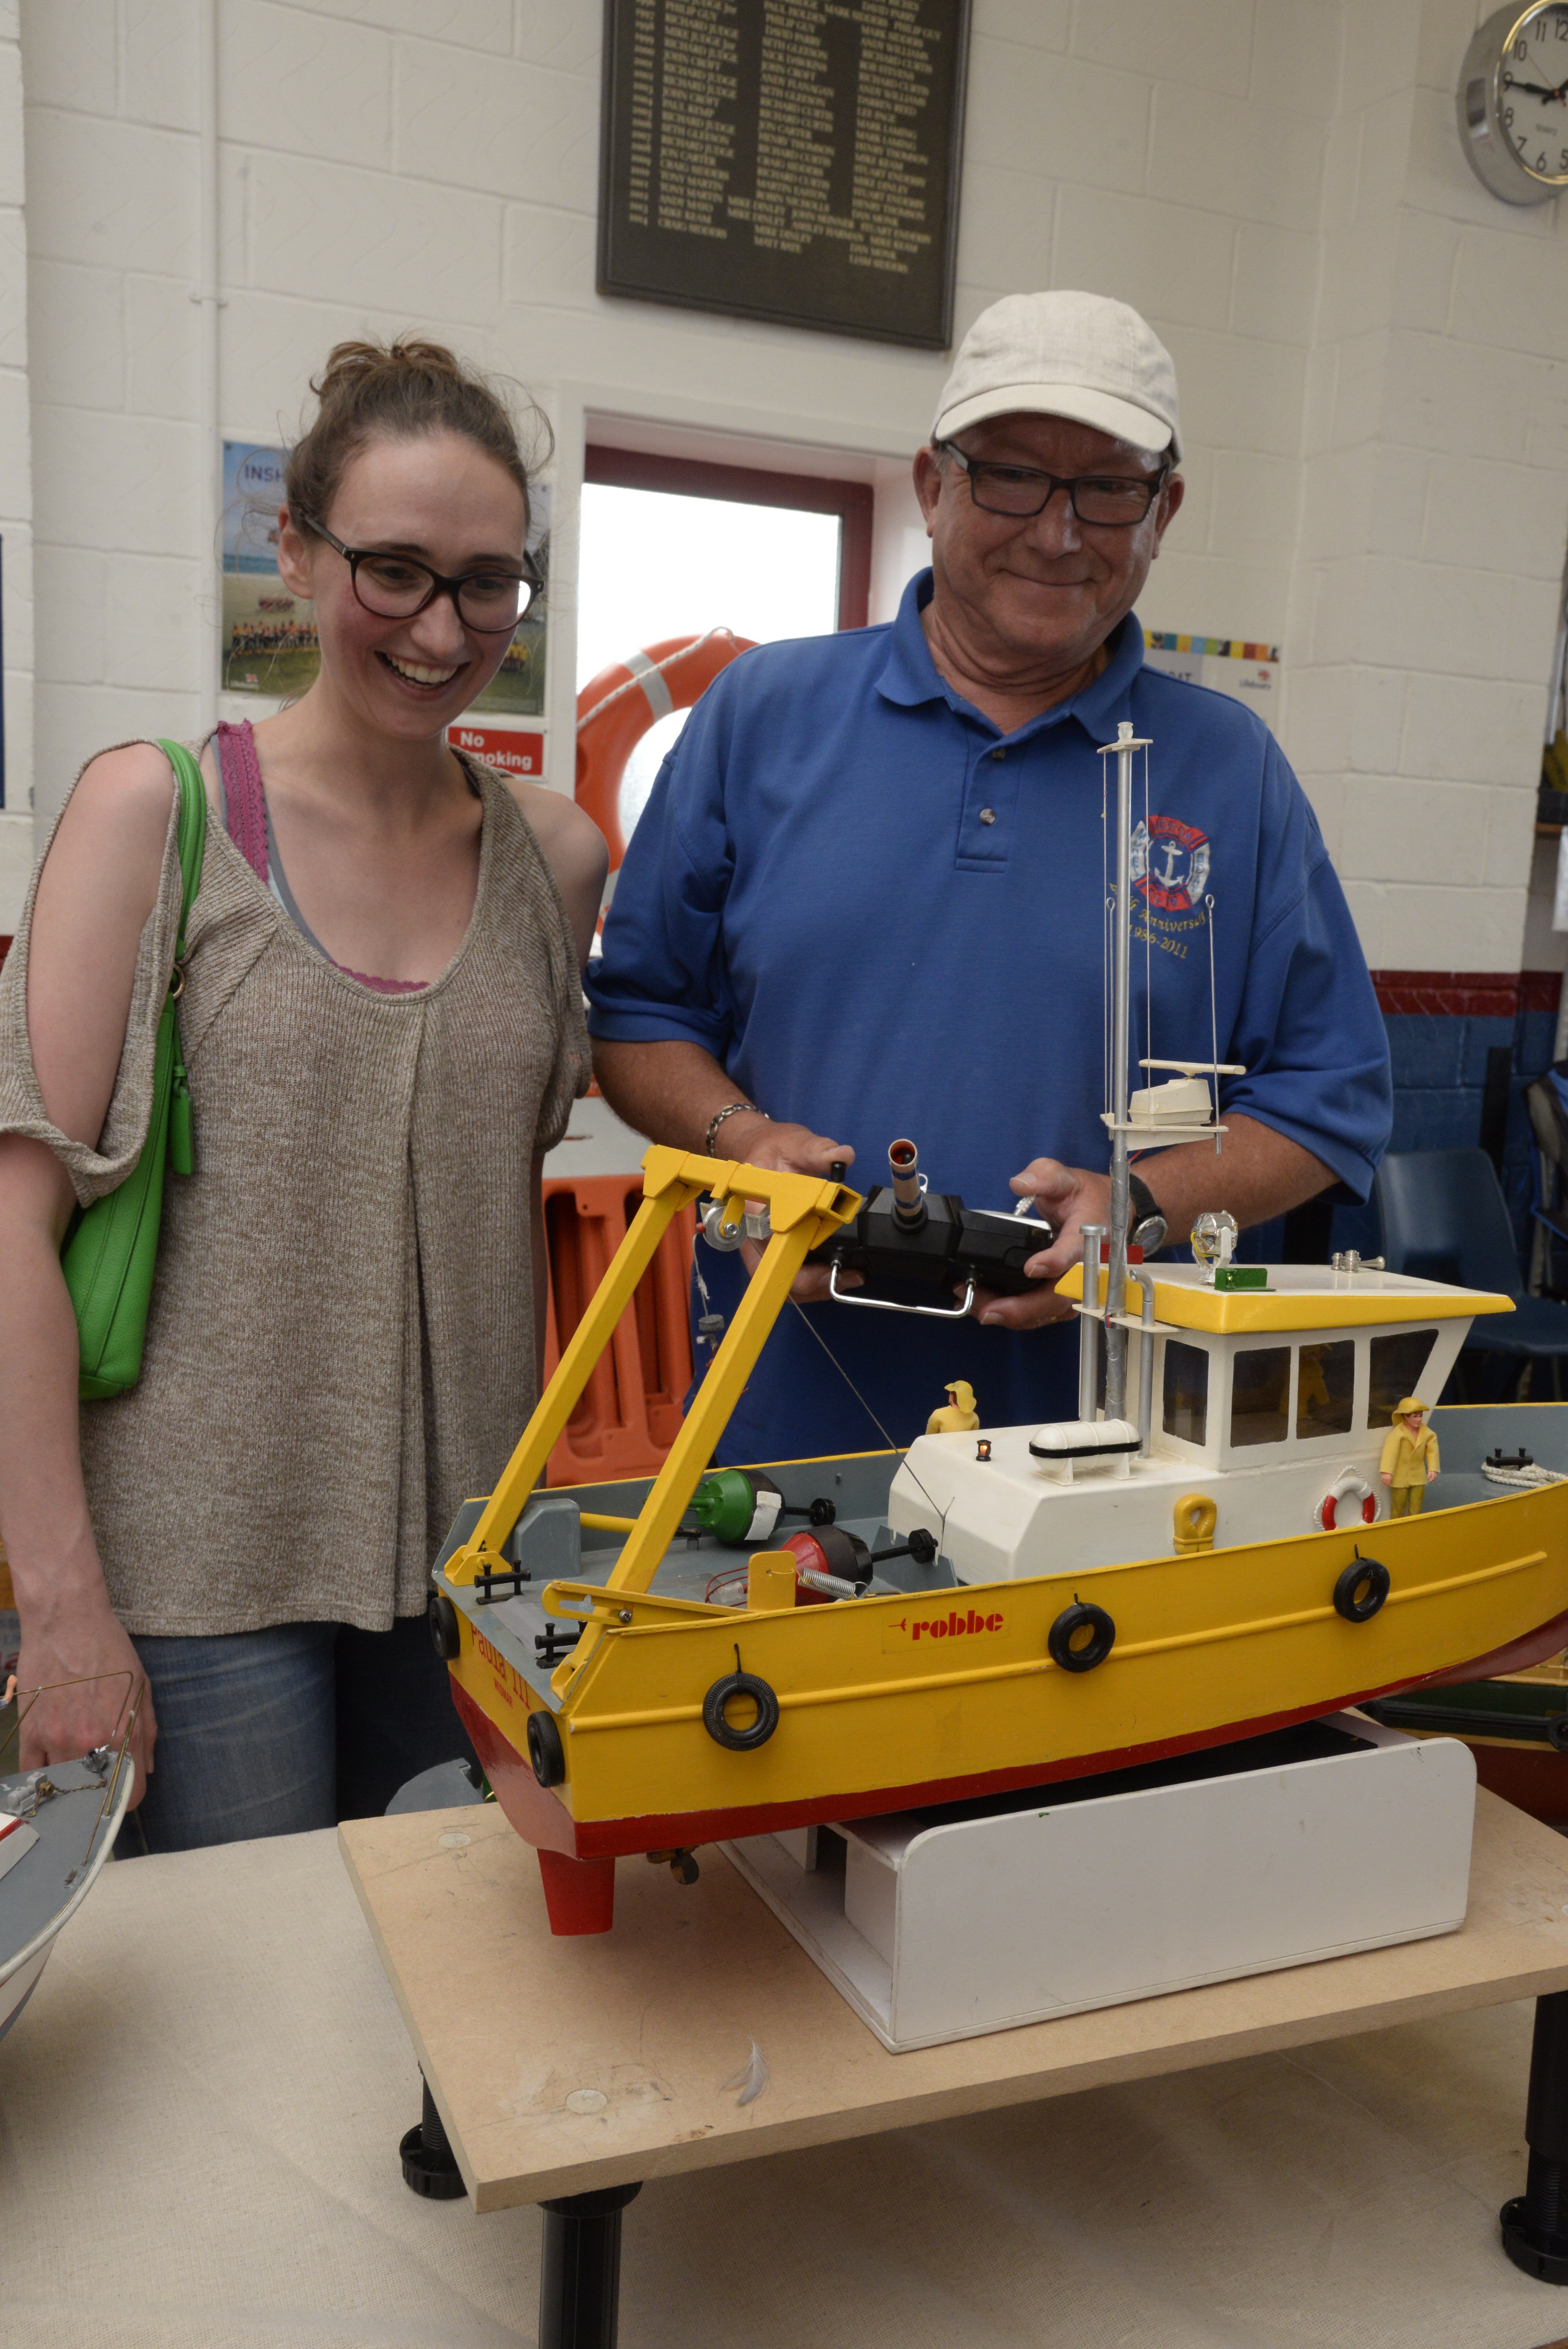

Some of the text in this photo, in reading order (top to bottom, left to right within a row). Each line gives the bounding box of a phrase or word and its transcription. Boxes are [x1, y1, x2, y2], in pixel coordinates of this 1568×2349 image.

[1536, 21, 1546, 42] 11
[1555, 18, 1568, 41] 12
[1513, 41, 1527, 61] 10
[1503, 71, 1513, 91] 9
[1504, 107, 1513, 128] 8
[1518, 136, 1527, 152] 7
[1536, 151, 1546, 172] 6
[460, 731, 485, 748] No
[912, 1610, 1004, 1640] robbe
[470, 1621, 507, 1682] Paula
[494, 1677, 513, 1709] WISMAR
